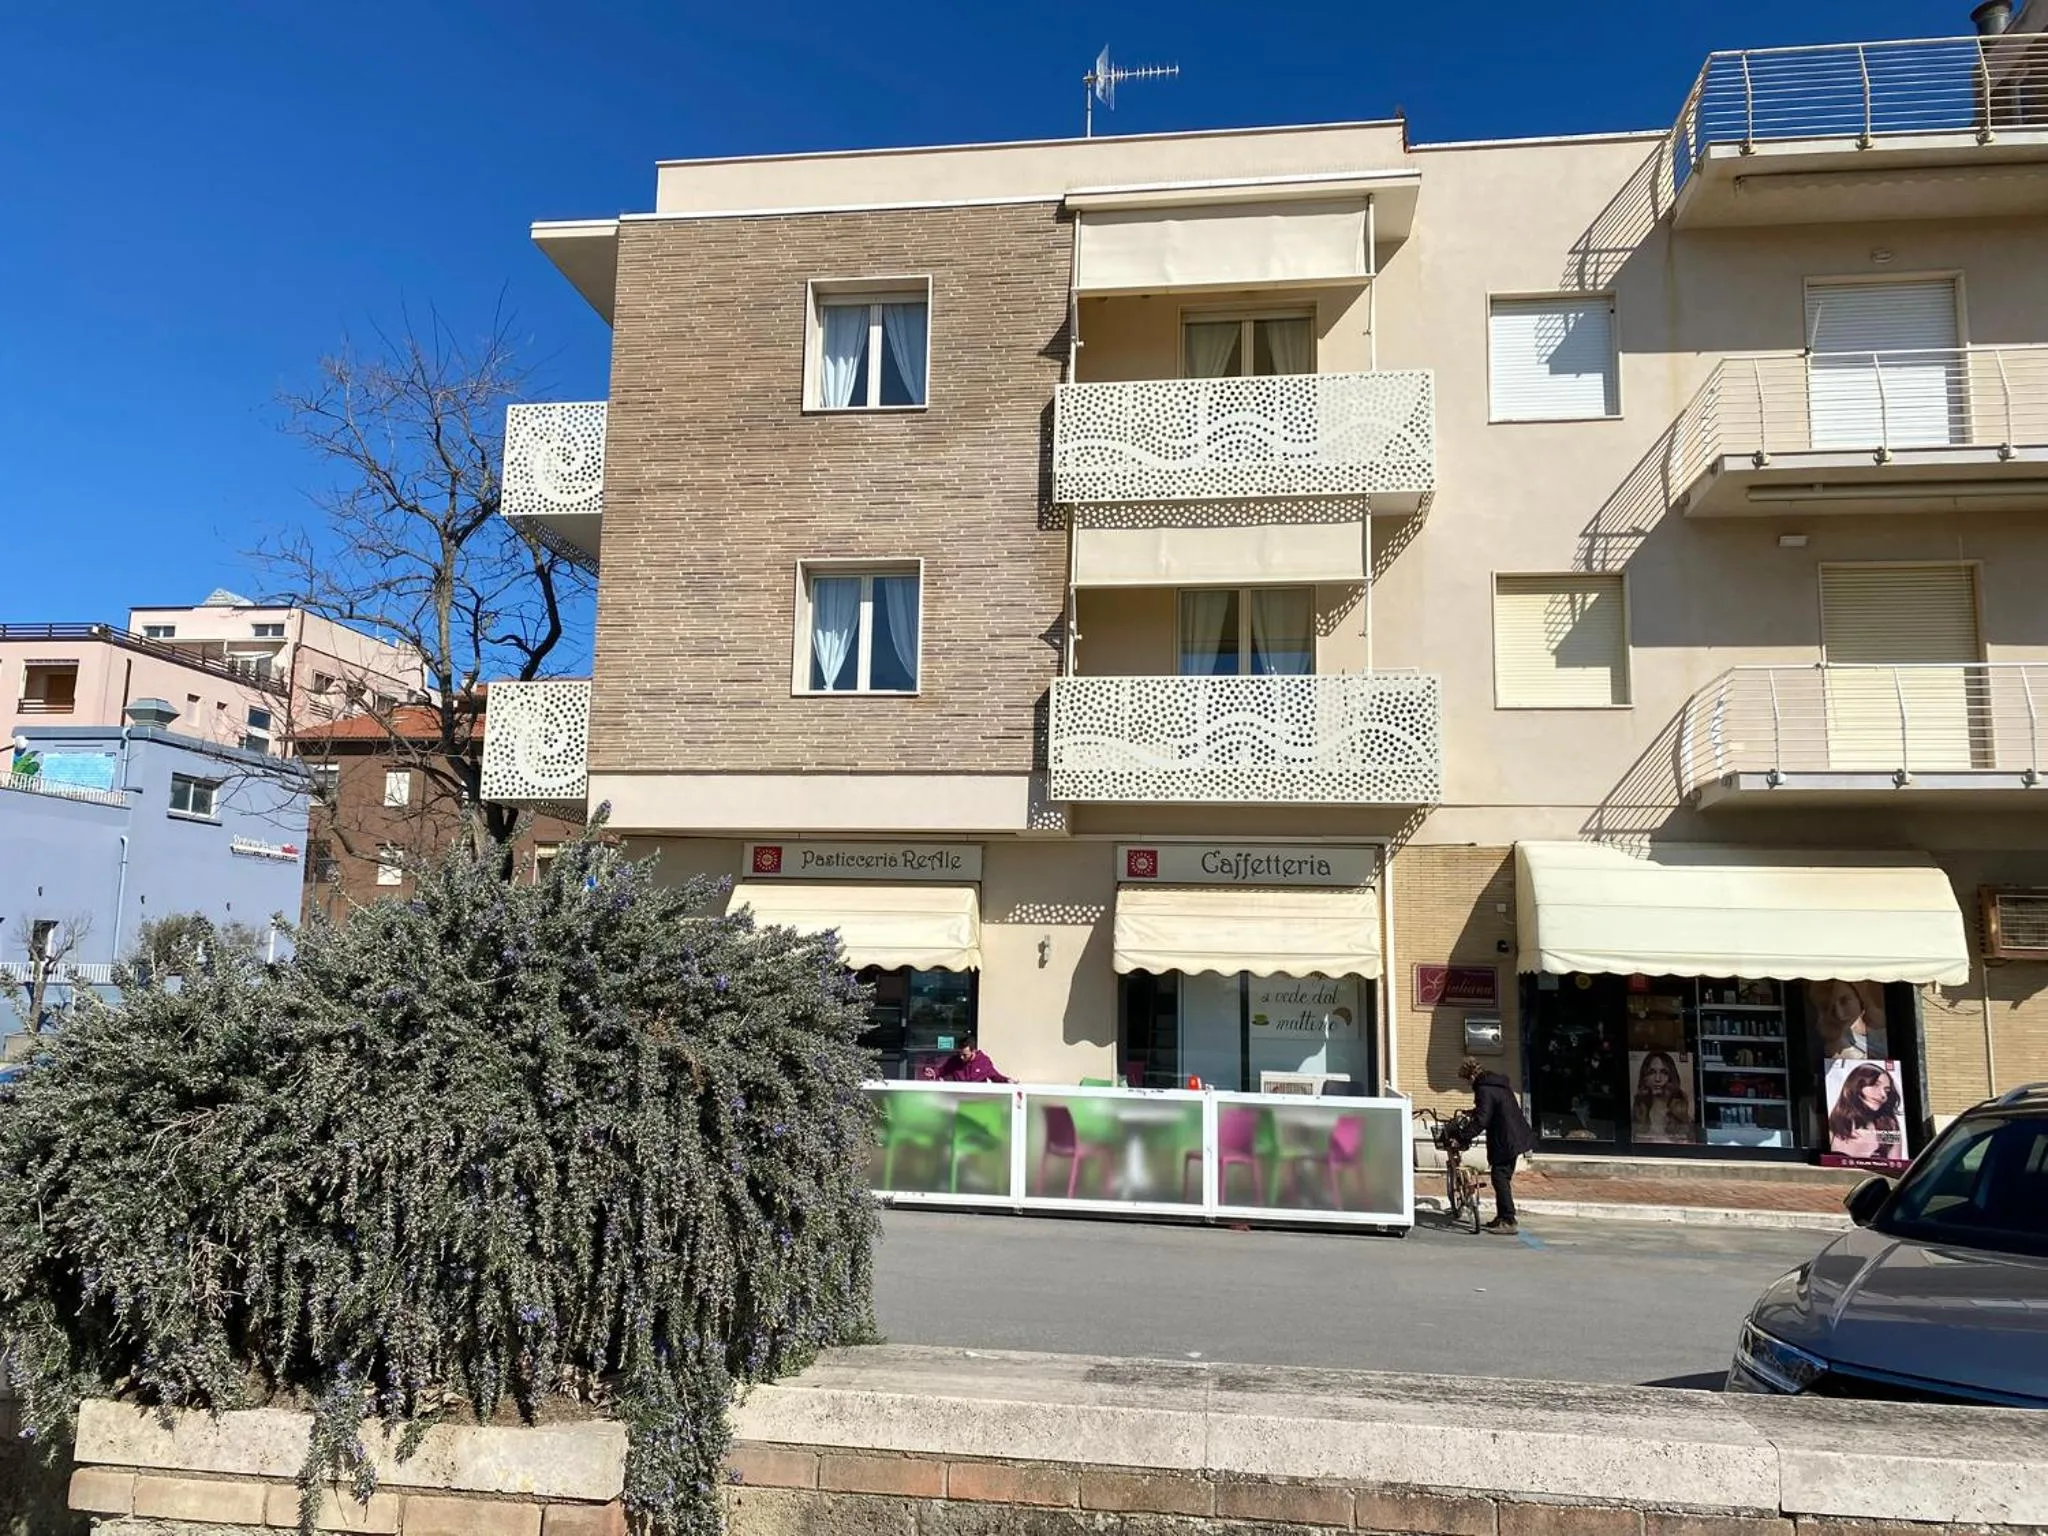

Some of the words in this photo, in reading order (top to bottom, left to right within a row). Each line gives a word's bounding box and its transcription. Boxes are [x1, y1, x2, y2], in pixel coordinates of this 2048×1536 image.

[801, 850, 898, 870] Pasticceria
[1200, 850, 1332, 879] Caffetteria
[1274, 984, 1309, 1005] vede
[1312, 983, 1340, 1005] dal
